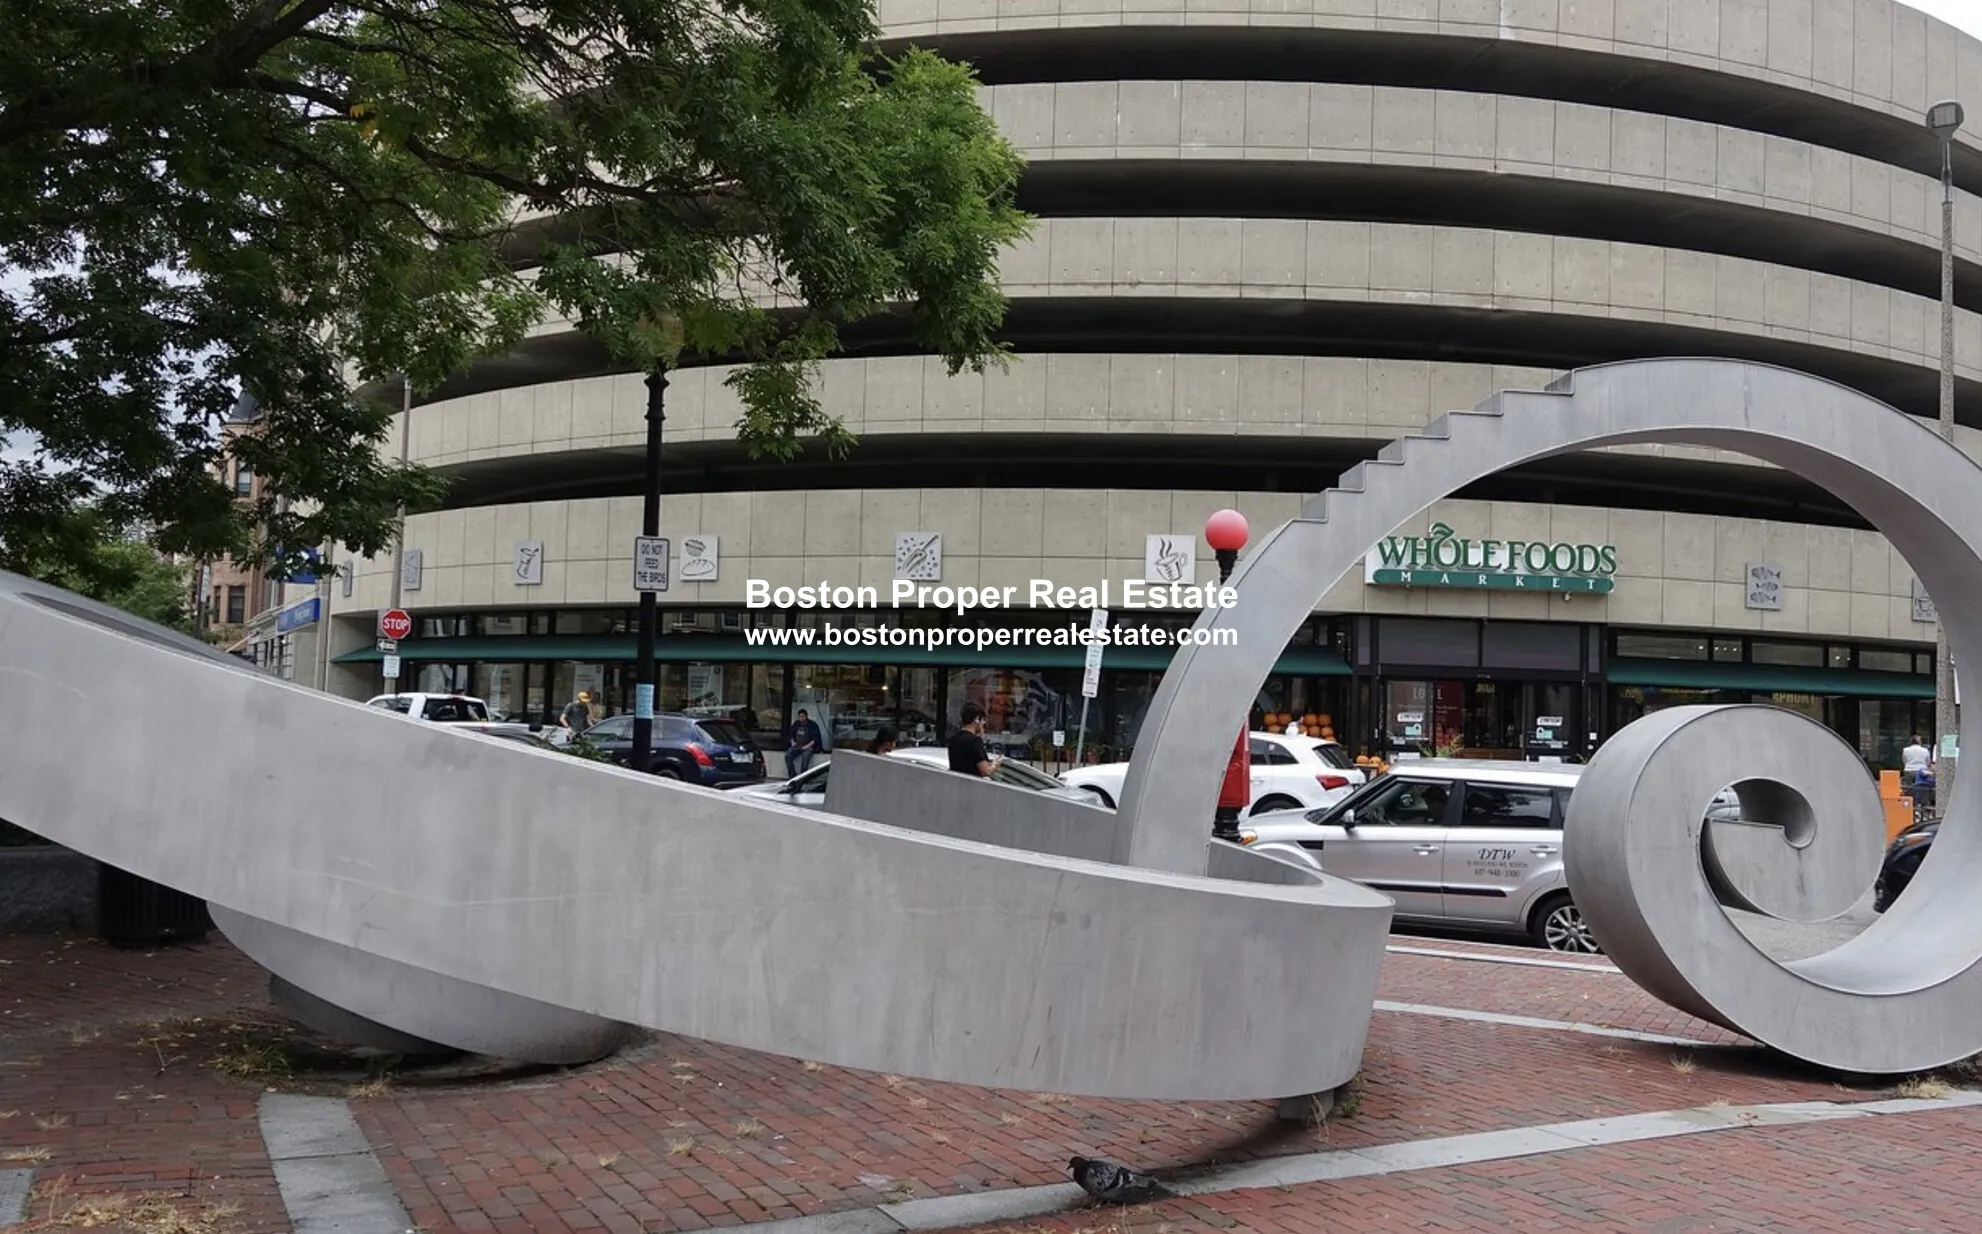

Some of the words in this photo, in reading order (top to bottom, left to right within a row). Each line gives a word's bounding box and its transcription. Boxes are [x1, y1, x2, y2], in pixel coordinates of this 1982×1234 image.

[642, 543, 650, 555] DO
[651, 544, 663, 556] NOT
[1378, 532, 1501, 569] WHOLE
[1503, 541, 1617, 575] FOODS
[644, 557, 659, 569] FEED
[637, 571, 648, 582] THE
[649, 571, 665, 583] BIRDS
[1401, 570, 1597, 590] MARKET
[383, 618, 409, 630] STOP
[1478, 848, 1516, 860] DTW
